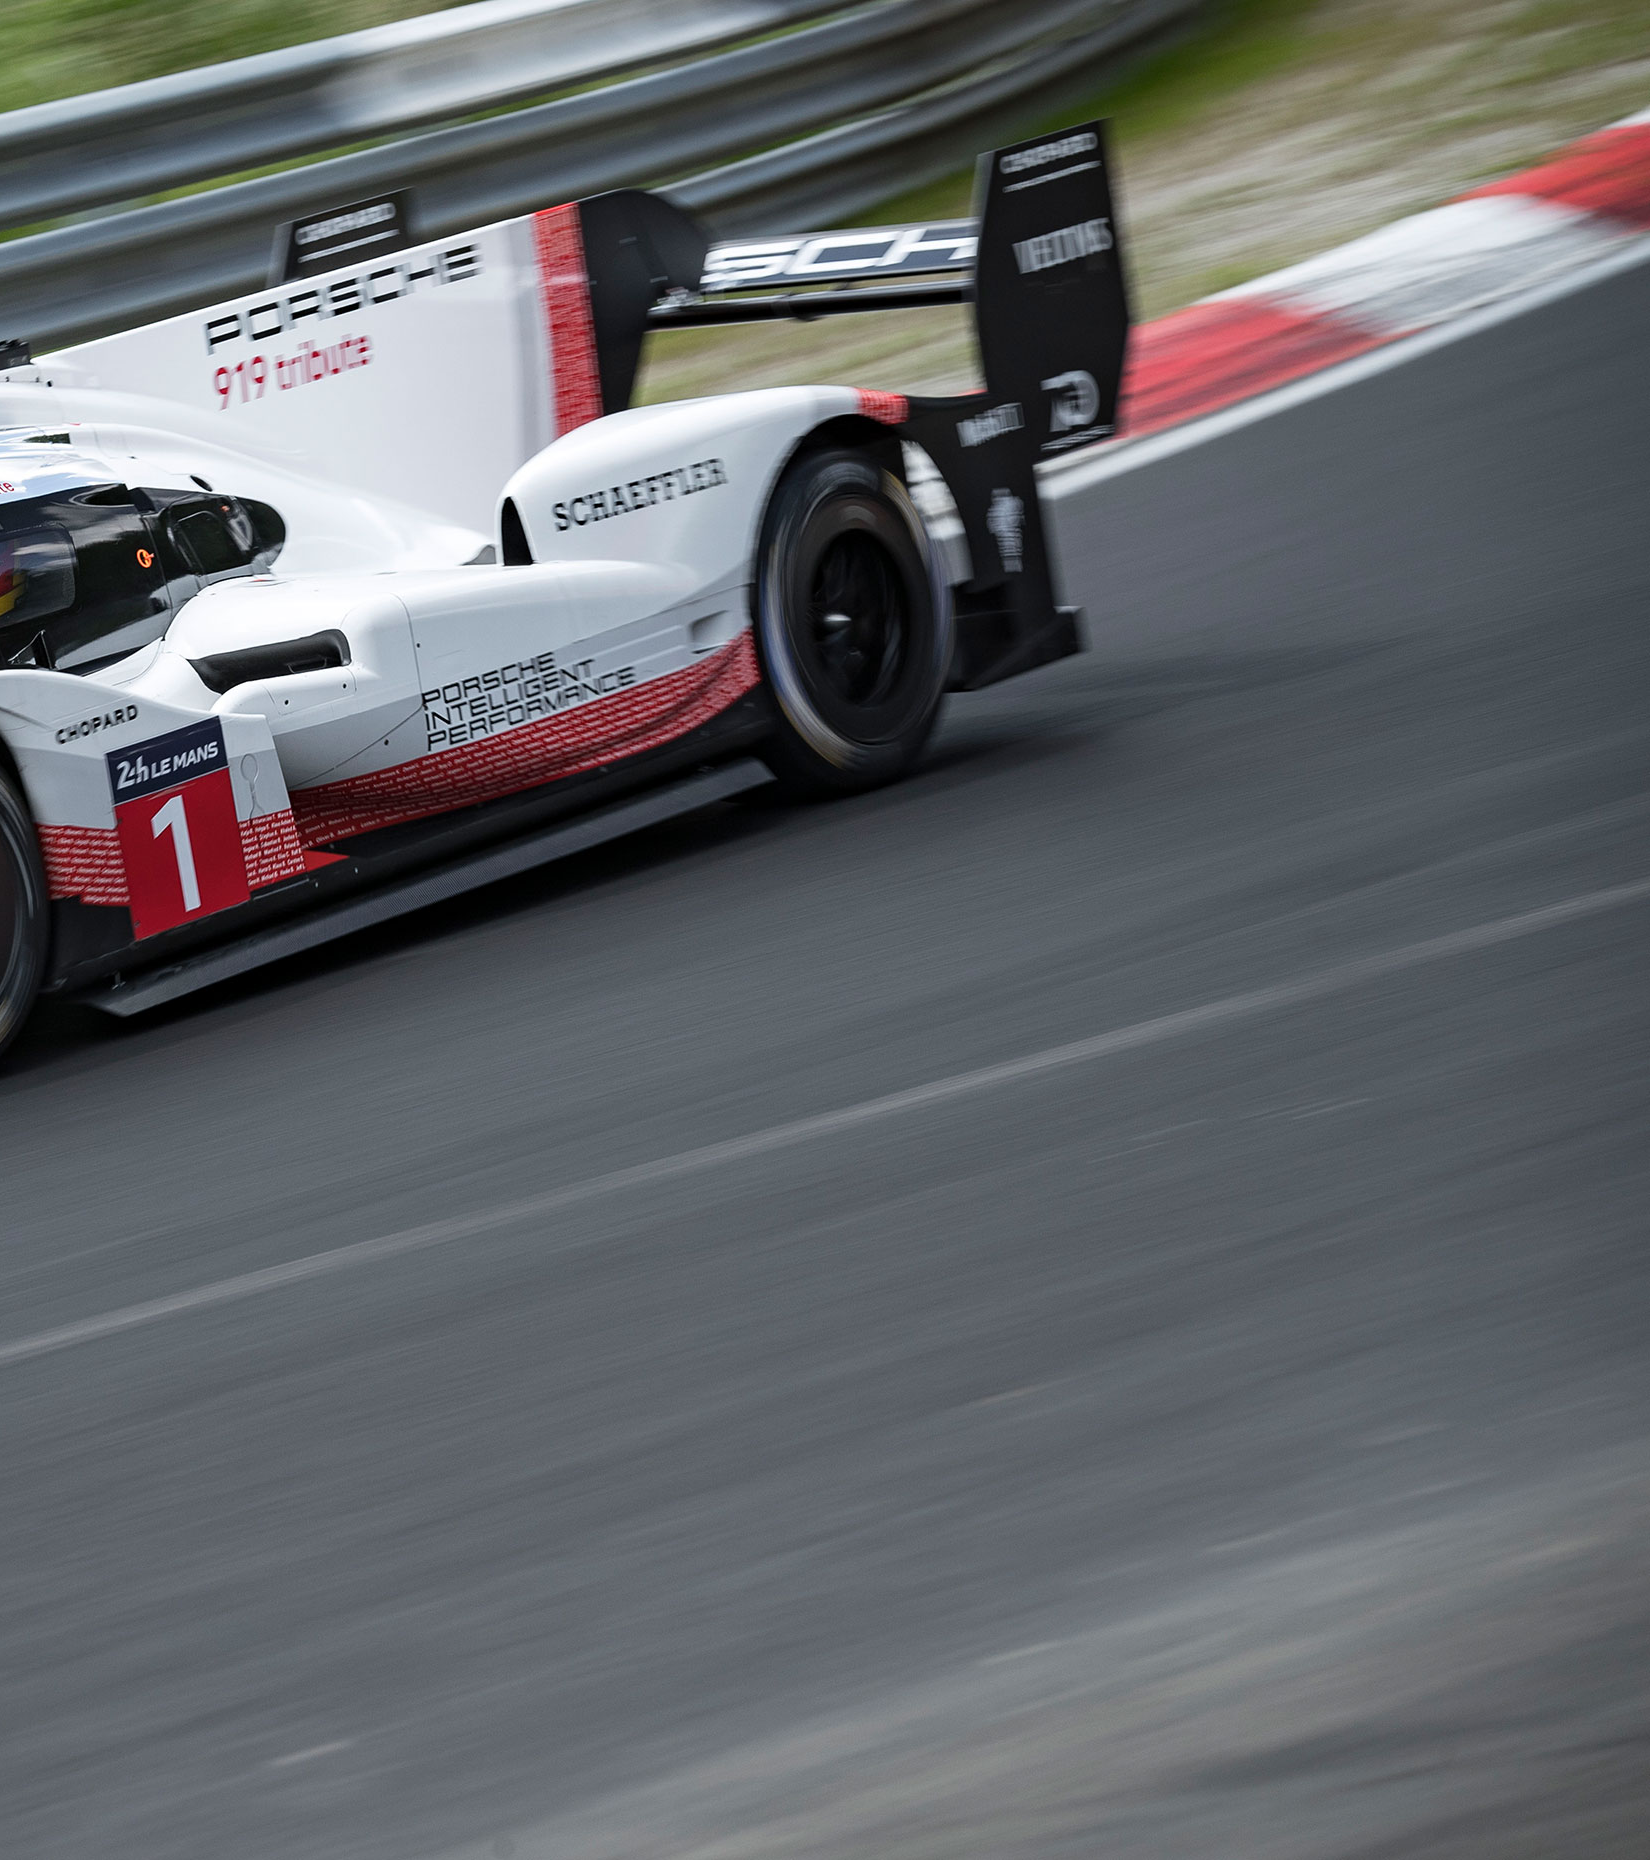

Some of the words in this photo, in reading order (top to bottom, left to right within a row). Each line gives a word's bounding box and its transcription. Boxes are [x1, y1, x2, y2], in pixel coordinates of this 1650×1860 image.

[204, 243, 485, 356] PORSCHE
[214, 355, 267, 411] 919
[275, 333, 374, 391] tribute
[552, 458, 729, 532] SCHAEFFLER
[422, 652, 554, 705] PORSCHE
[425, 658, 595, 731] INTELLIGENT
[428, 666, 636, 751] PERFORMANCE
[55, 704, 138, 745] CHOPARD
[116, 755, 149, 790] 24h
[151, 758, 171, 779] LE
[173, 741, 219, 772] MANS
[151, 795, 201, 912] 1
